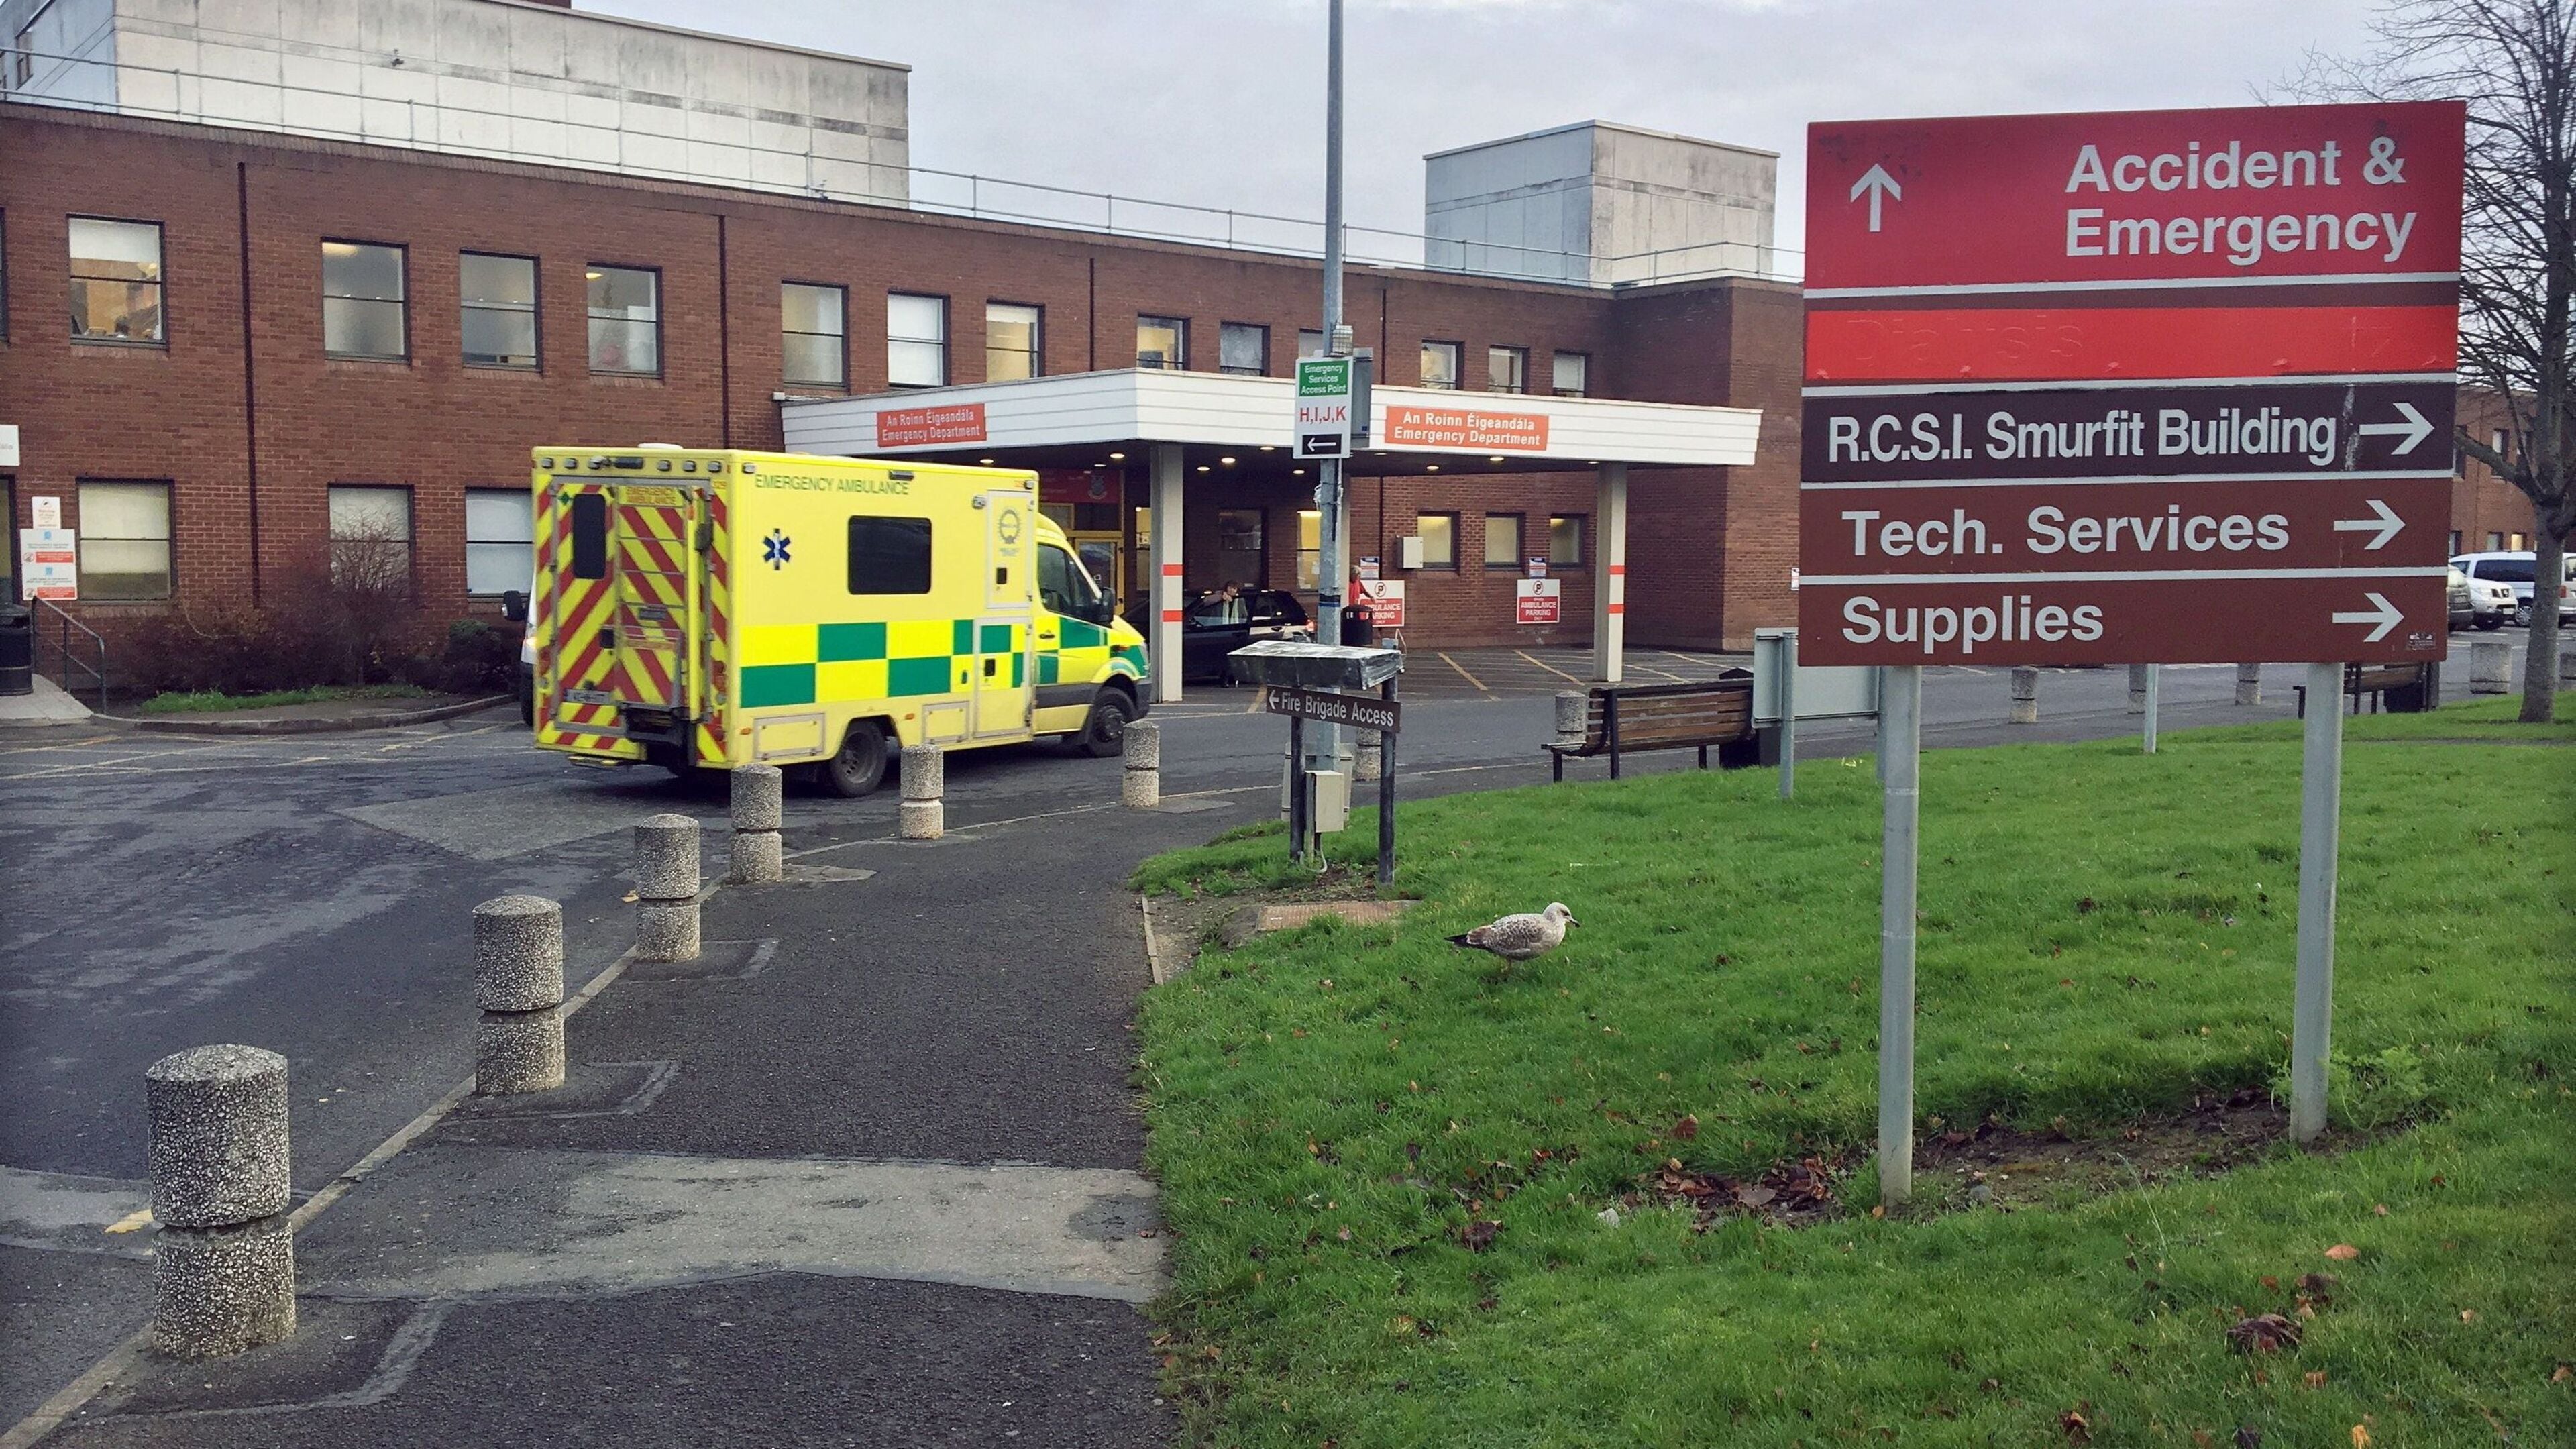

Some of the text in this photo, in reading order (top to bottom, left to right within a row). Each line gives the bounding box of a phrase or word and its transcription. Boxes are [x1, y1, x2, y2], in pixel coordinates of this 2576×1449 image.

[2065, 135, 2406, 193] Accident &
[2065, 209, 2417, 266] Emergency
[1305, 364, 1343, 374] Emergency
[1309, 374, 1338, 383] Services
[1301, 384, 1346, 394] Access Point
[887, 409, 974, 426] An Roinn Éigeandála
[1403, 411, 1534, 430] An Roinn Éigeandála
[882, 425, 980, 442] Emergency Department
[1394, 426, 1540, 445] Emergency Department
[1828, 407, 2337, 466] R.C.S.I. Smurfit Building
[755, 474, 909, 495] EMERGENCY AMBULANCE
[1842, 505, 2289, 556] Tech. Services
[1842, 596, 2104, 654] Supplies
[1282, 692, 1394, 727] Fire Brigade Access
